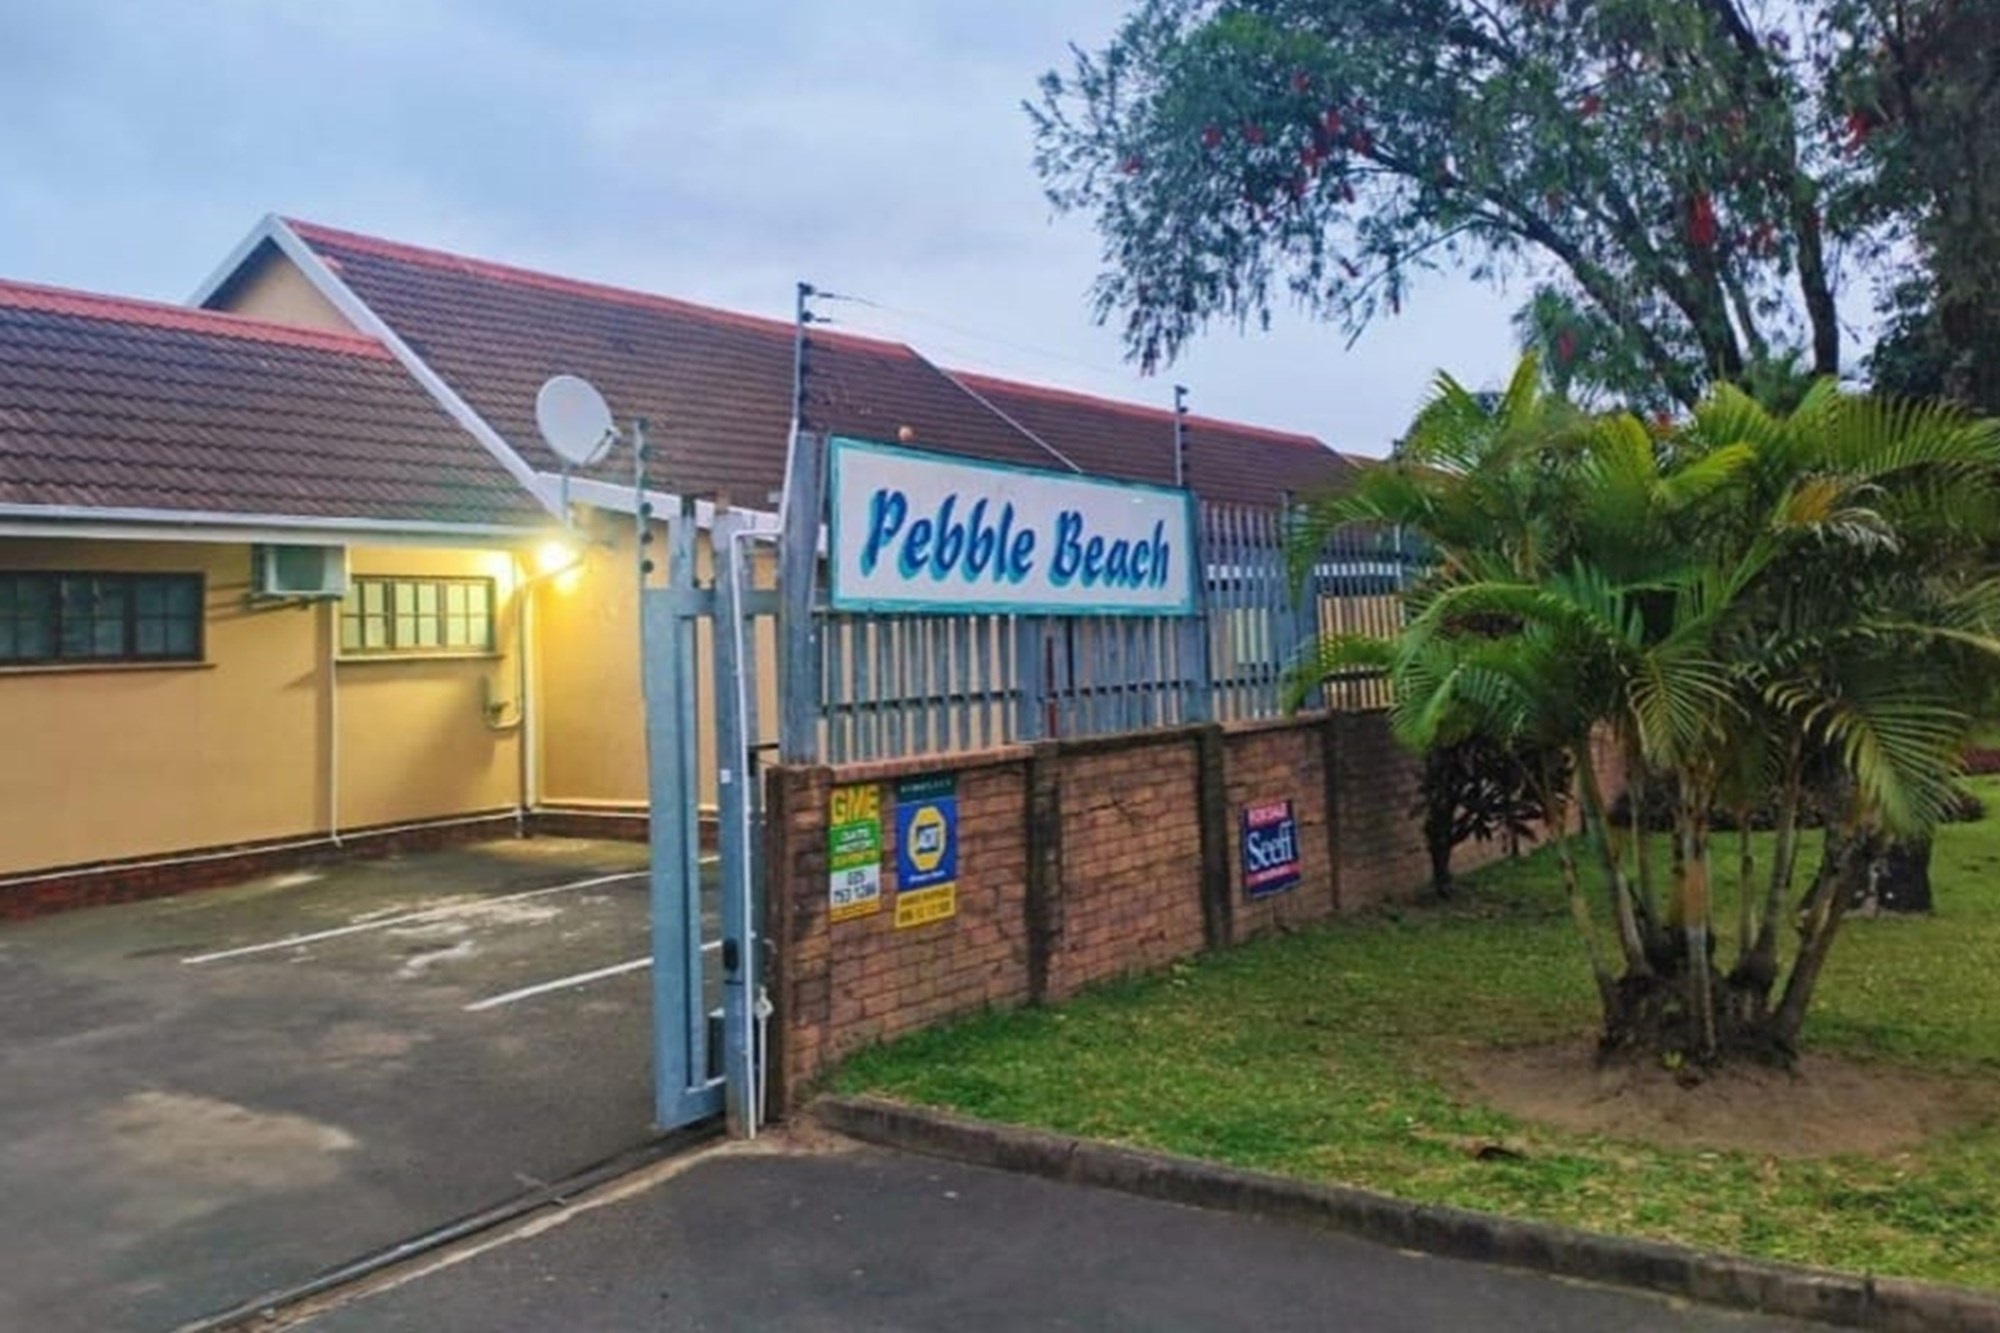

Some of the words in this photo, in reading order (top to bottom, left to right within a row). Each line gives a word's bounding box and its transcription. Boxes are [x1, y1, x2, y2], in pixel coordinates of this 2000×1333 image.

[861, 488, 1035, 584] Pebble
[1050, 510, 1169, 589] Beach
[1248, 821, 1293, 871] Seeff
